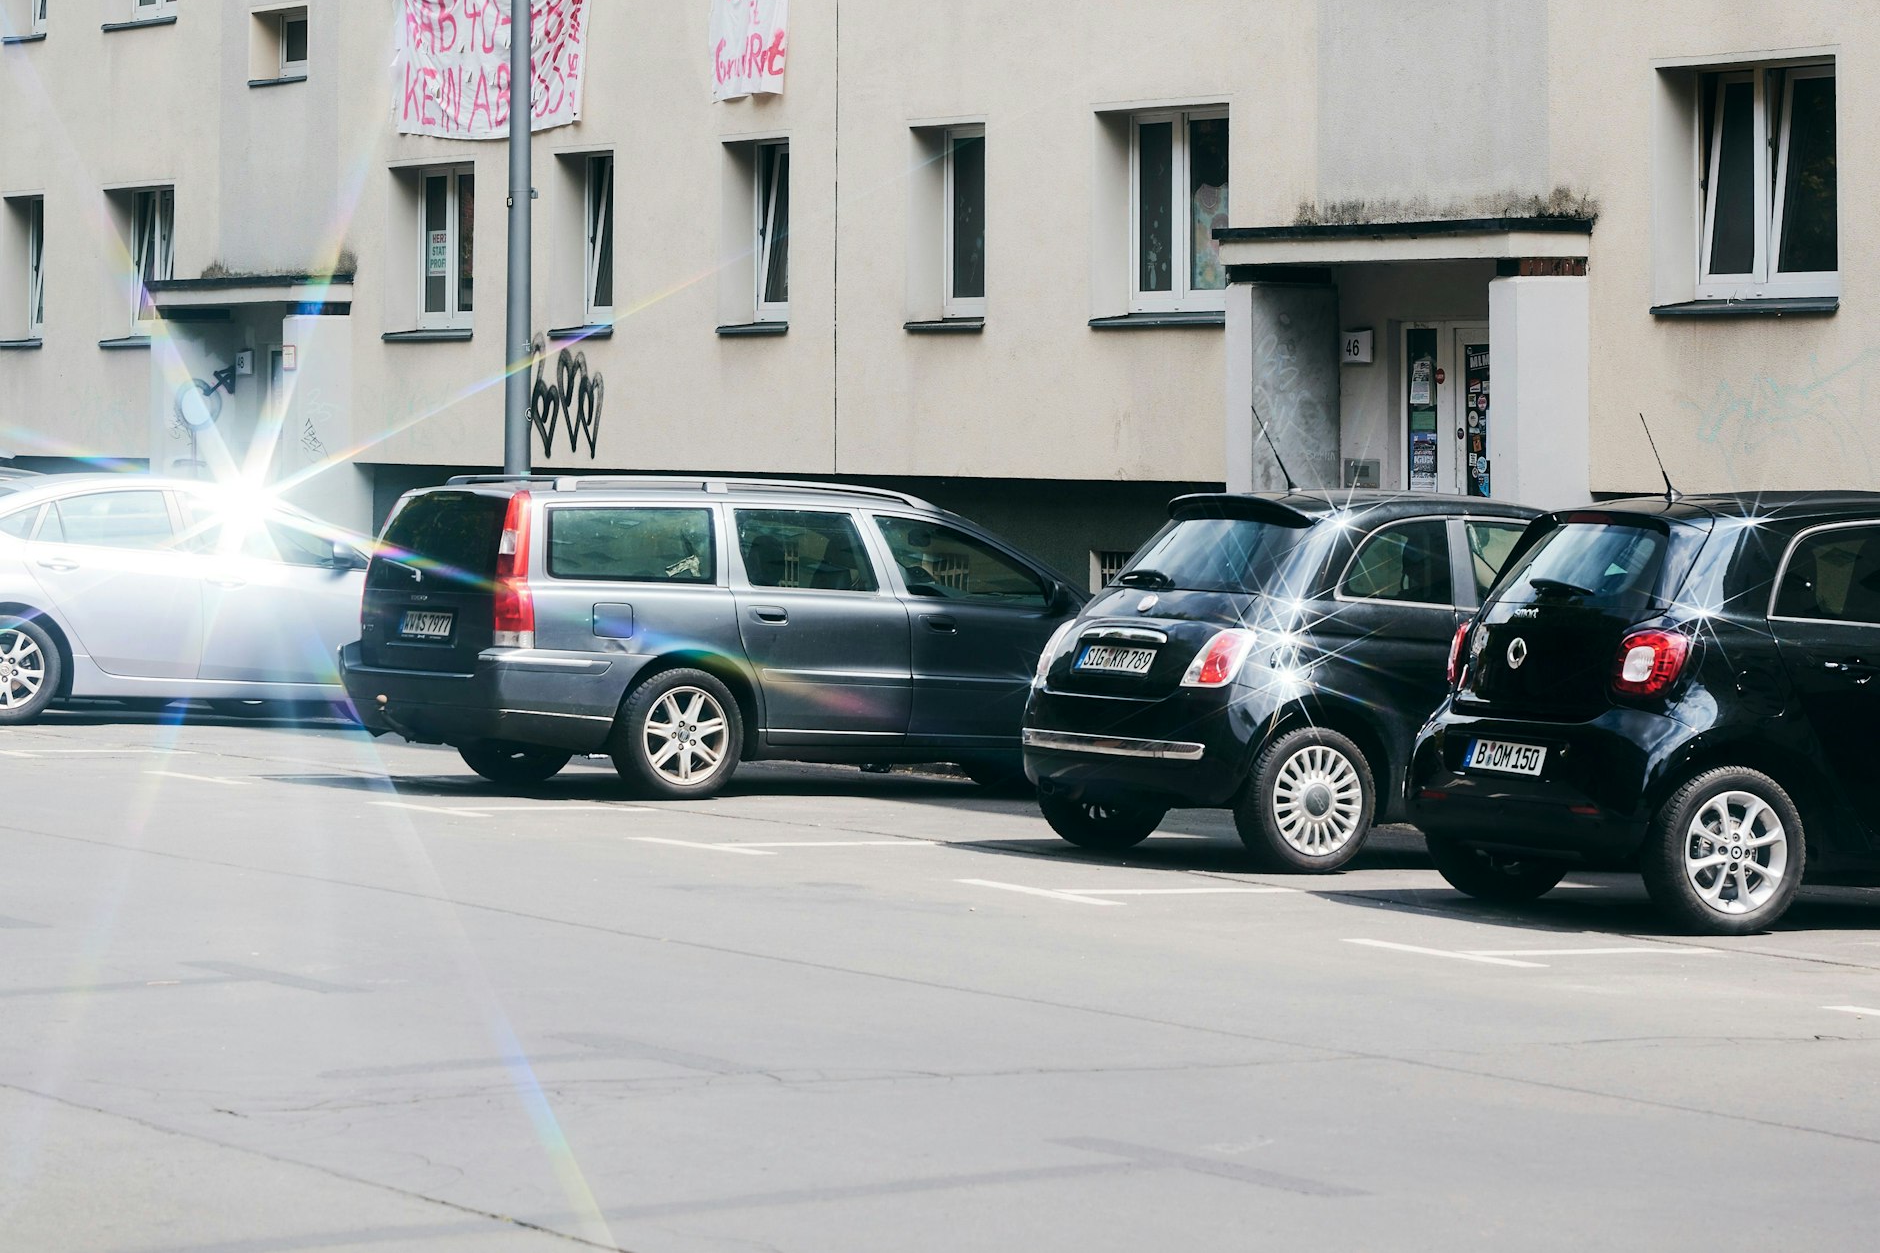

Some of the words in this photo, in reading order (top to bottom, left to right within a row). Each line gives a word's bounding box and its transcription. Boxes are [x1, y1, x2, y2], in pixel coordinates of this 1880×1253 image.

[404, 61, 462, 133] KEIN
[1345, 338, 1360, 356] 46
[1513, 607, 1539, 619] smart
[427, 615, 451, 633] 7977
[1083, 648, 1108, 666] SIG
[1109, 649, 1129, 668] KR
[1126, 650, 1152, 670] 789
[1476, 742, 1488, 764] B
[1492, 744, 1514, 767] OM
[1511, 747, 1540, 771] 150
